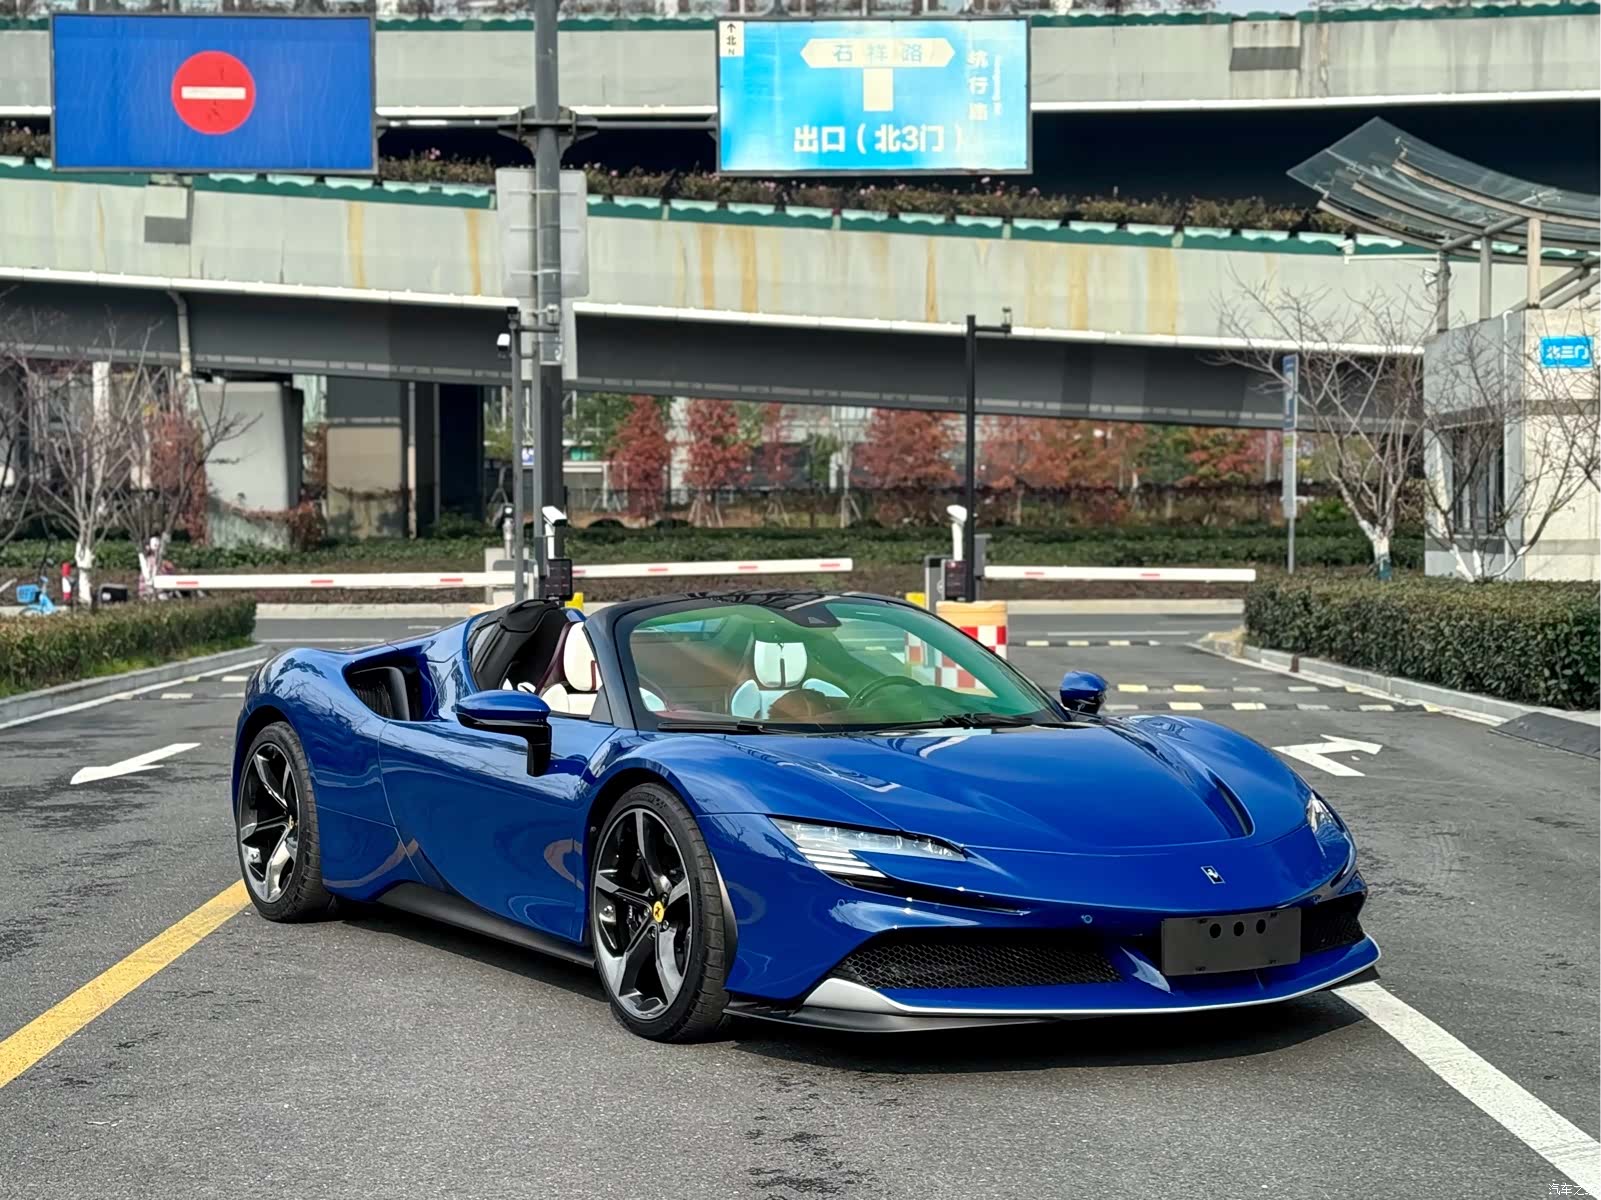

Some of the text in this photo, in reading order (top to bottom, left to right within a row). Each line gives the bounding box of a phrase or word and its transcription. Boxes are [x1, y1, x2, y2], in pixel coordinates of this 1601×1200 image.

[725, 35, 737, 46] 北
[728, 48, 735, 56] N
[1546, 345, 1589, 360] 北三门
